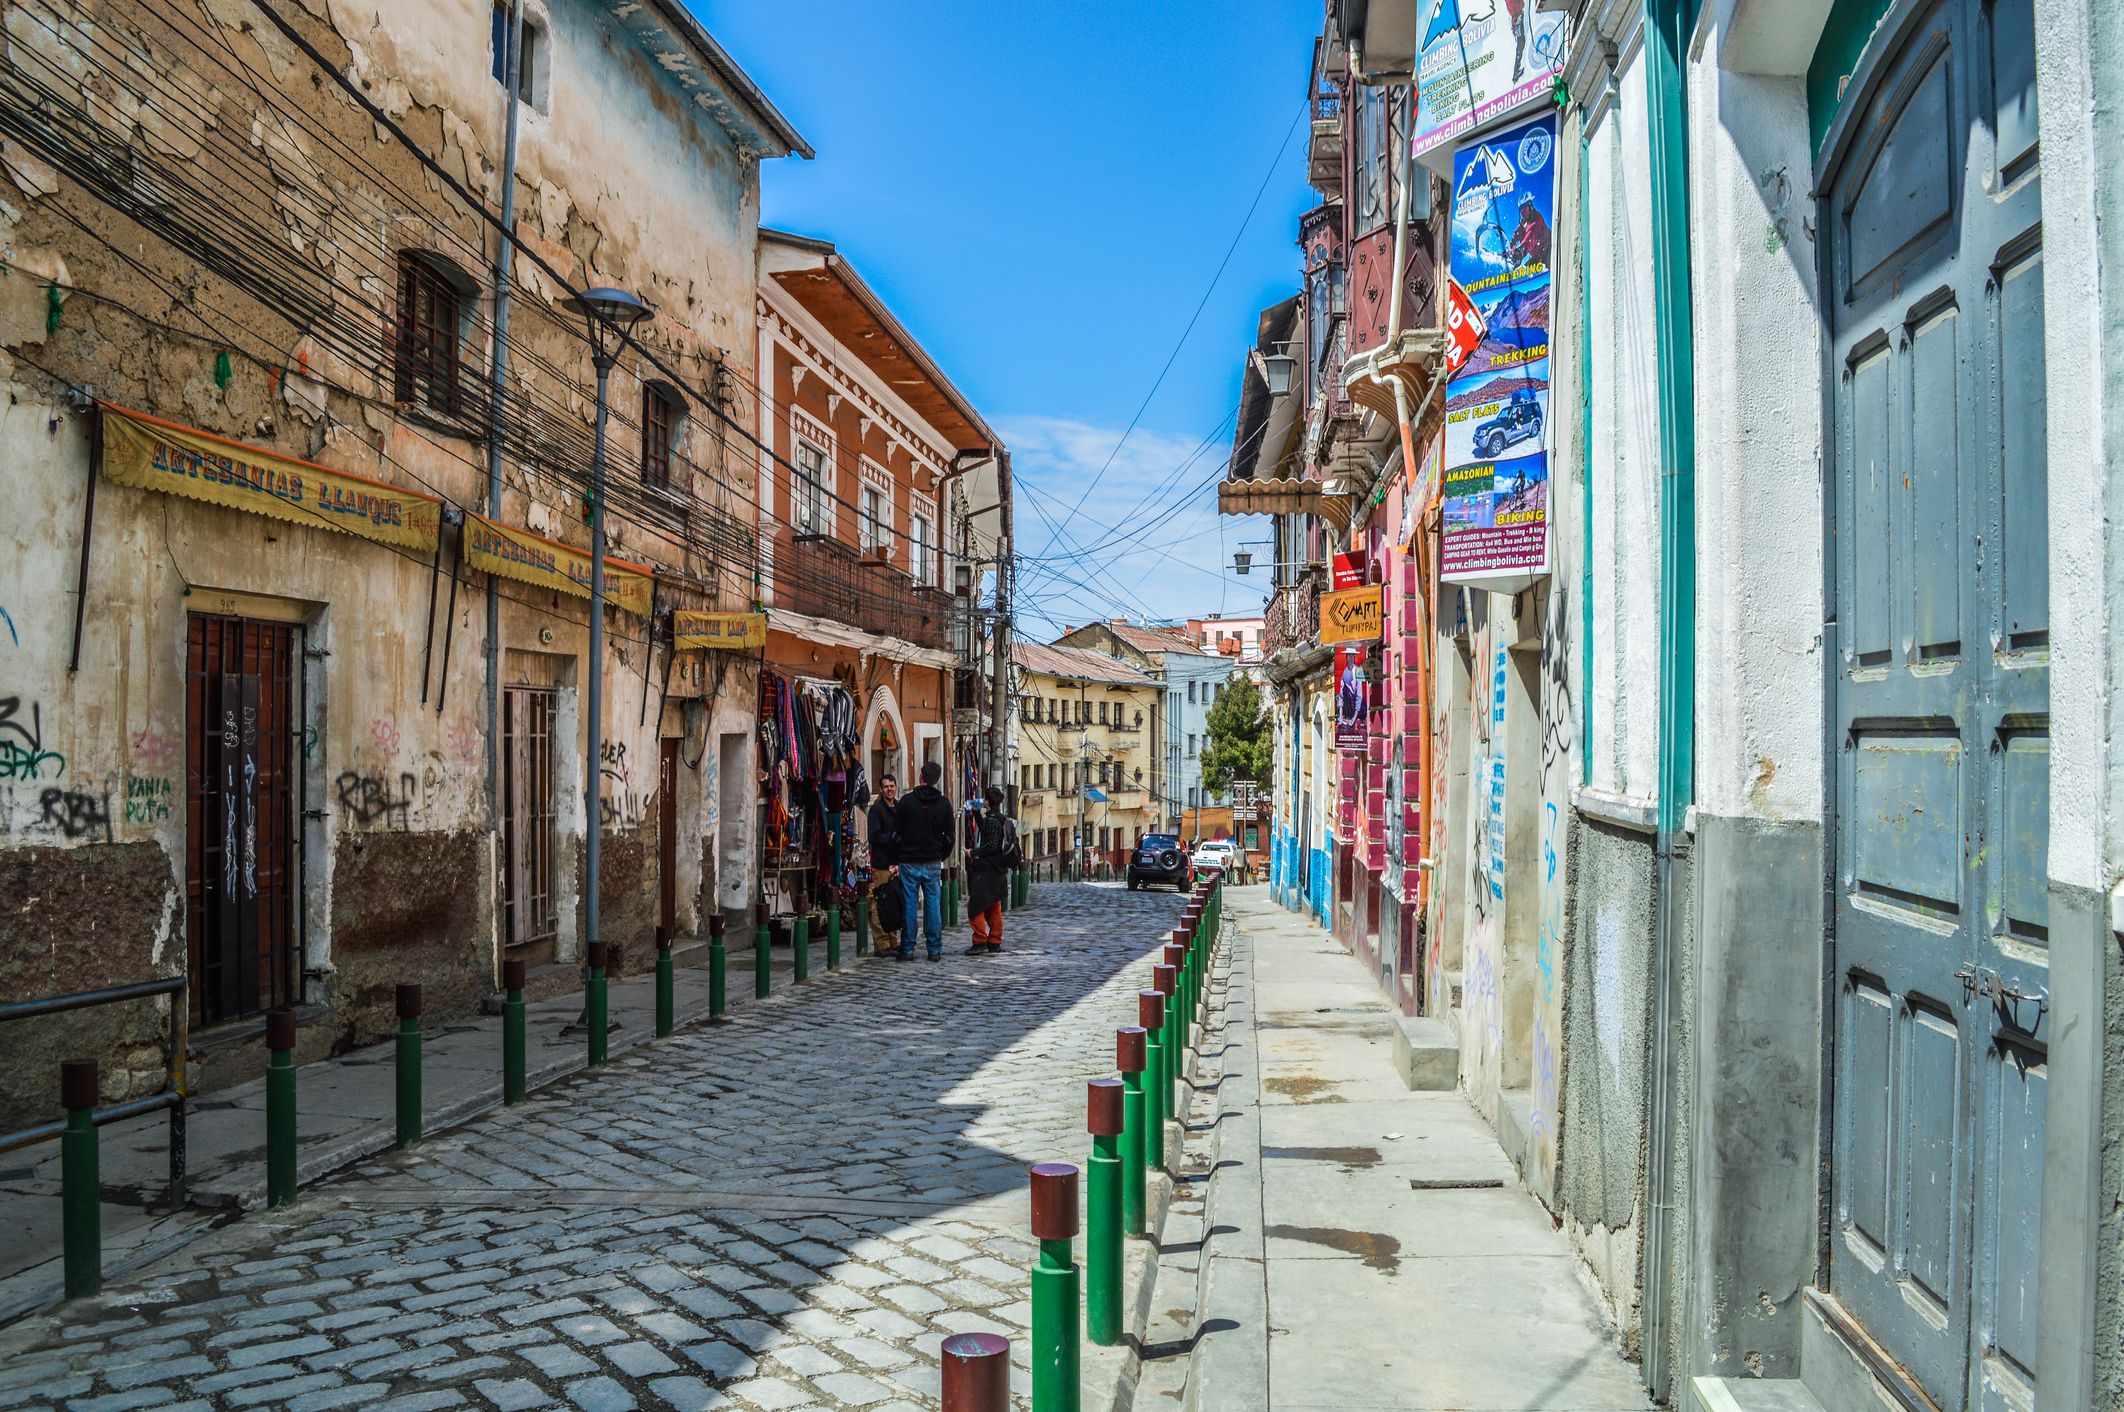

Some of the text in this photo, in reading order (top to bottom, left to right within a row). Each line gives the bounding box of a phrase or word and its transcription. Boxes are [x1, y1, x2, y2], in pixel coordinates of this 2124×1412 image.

[1421, 39, 1459, 70] CLIMBING
[1463, 18, 1496, 48] BOLIVIA
[1422, 51, 1494, 96] MOUNTAINEERING
[1431, 93, 1459, 114] BIKING
[1436, 106, 1457, 122] SALT
[1458, 183, 1514, 209] CLIMBING BOLIVIA
[1489, 344, 1547, 367] TREKKING
[1448, 403, 1500, 424] SALT FLATS
[150, 440, 303, 501] ARTESANIAS
[1446, 465, 1495, 483] AMAZONIAN
[1496, 509, 1545, 526] BIKING
[1445, 535, 1462, 543] EXPERT
[472, 528, 556, 574] ARTESANIAS
[1443, 554, 1544, 571] www.climbingbolivia.com
